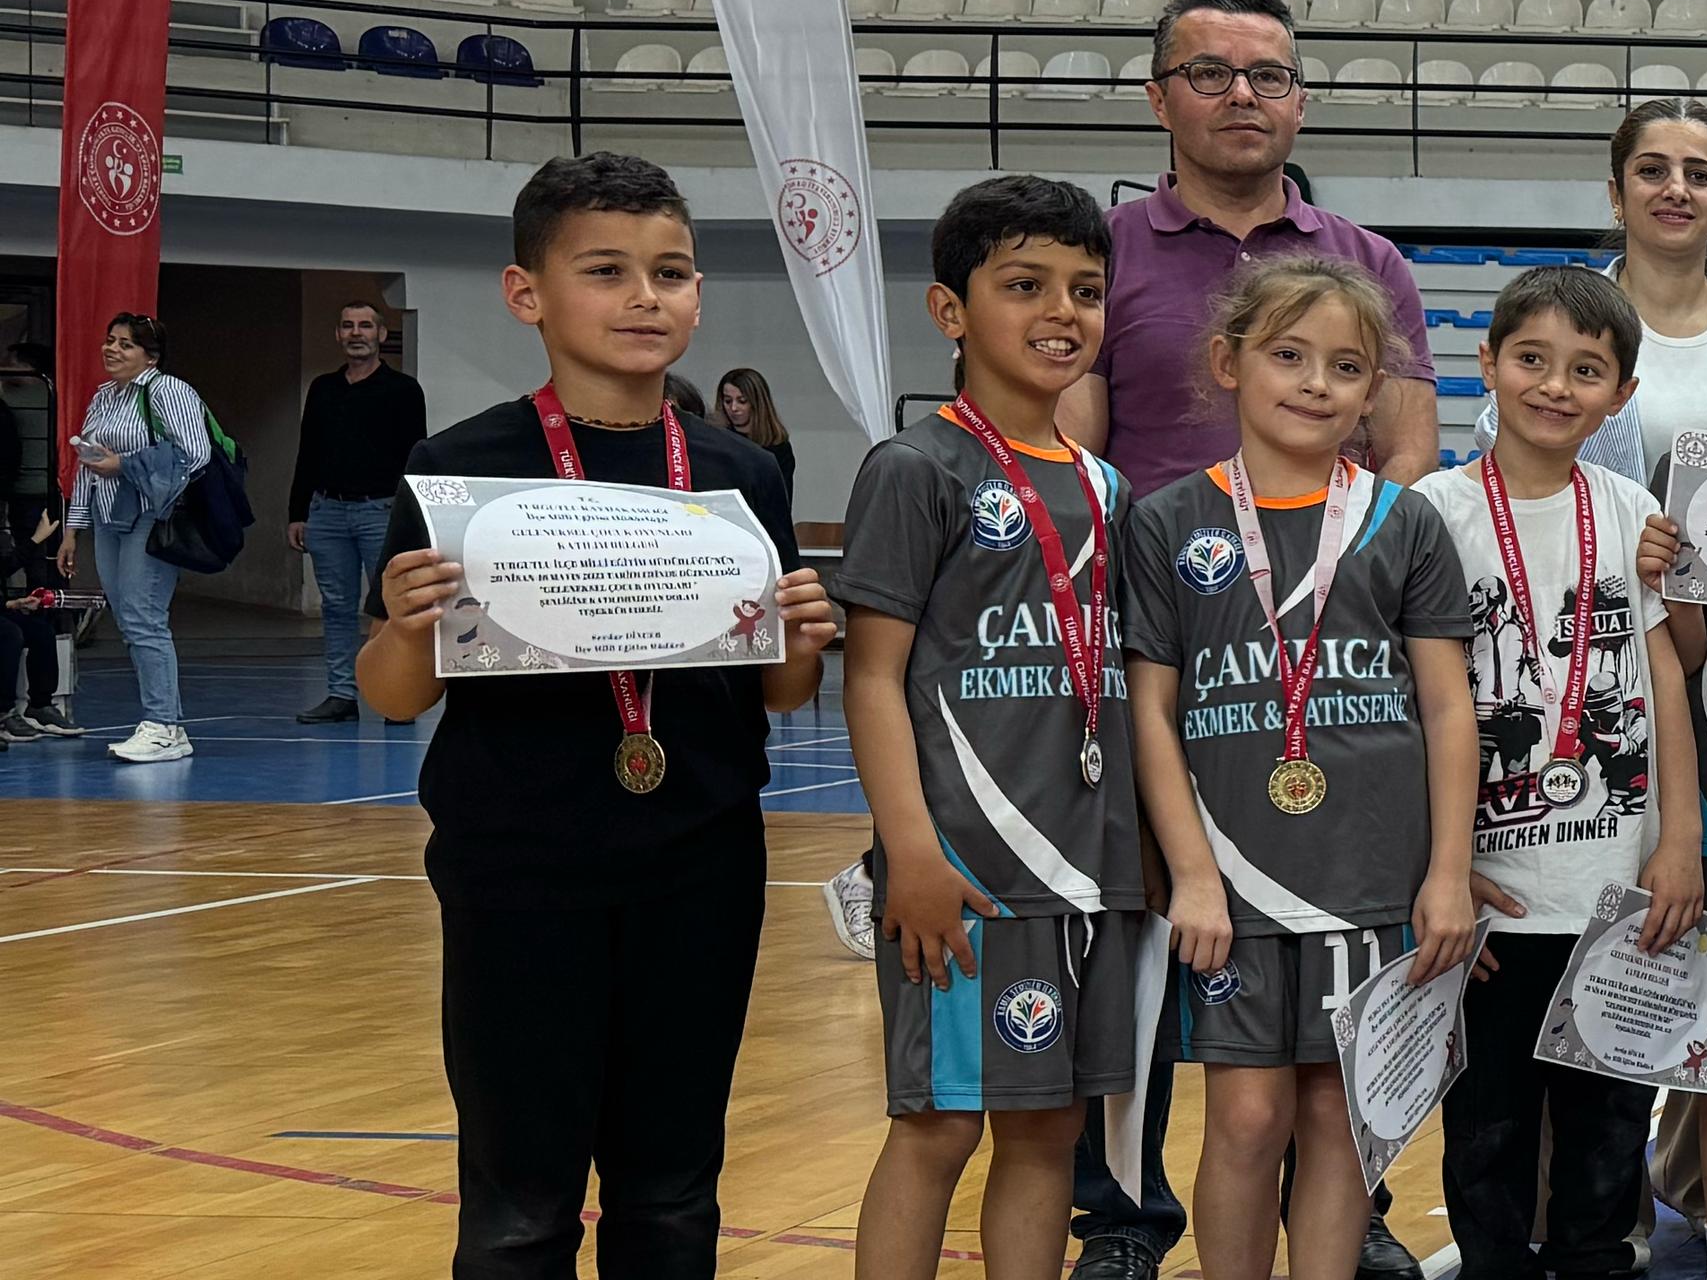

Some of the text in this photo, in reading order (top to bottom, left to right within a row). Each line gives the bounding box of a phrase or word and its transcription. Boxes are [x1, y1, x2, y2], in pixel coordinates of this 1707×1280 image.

[960, 665, 1054, 700] EKMEK
[1184, 686, 1409, 741] EKMEK & ATİSSERİE
[1476, 817, 1618, 854] CHICKEN DINNER
[1321, 929, 1382, 1011] 11
